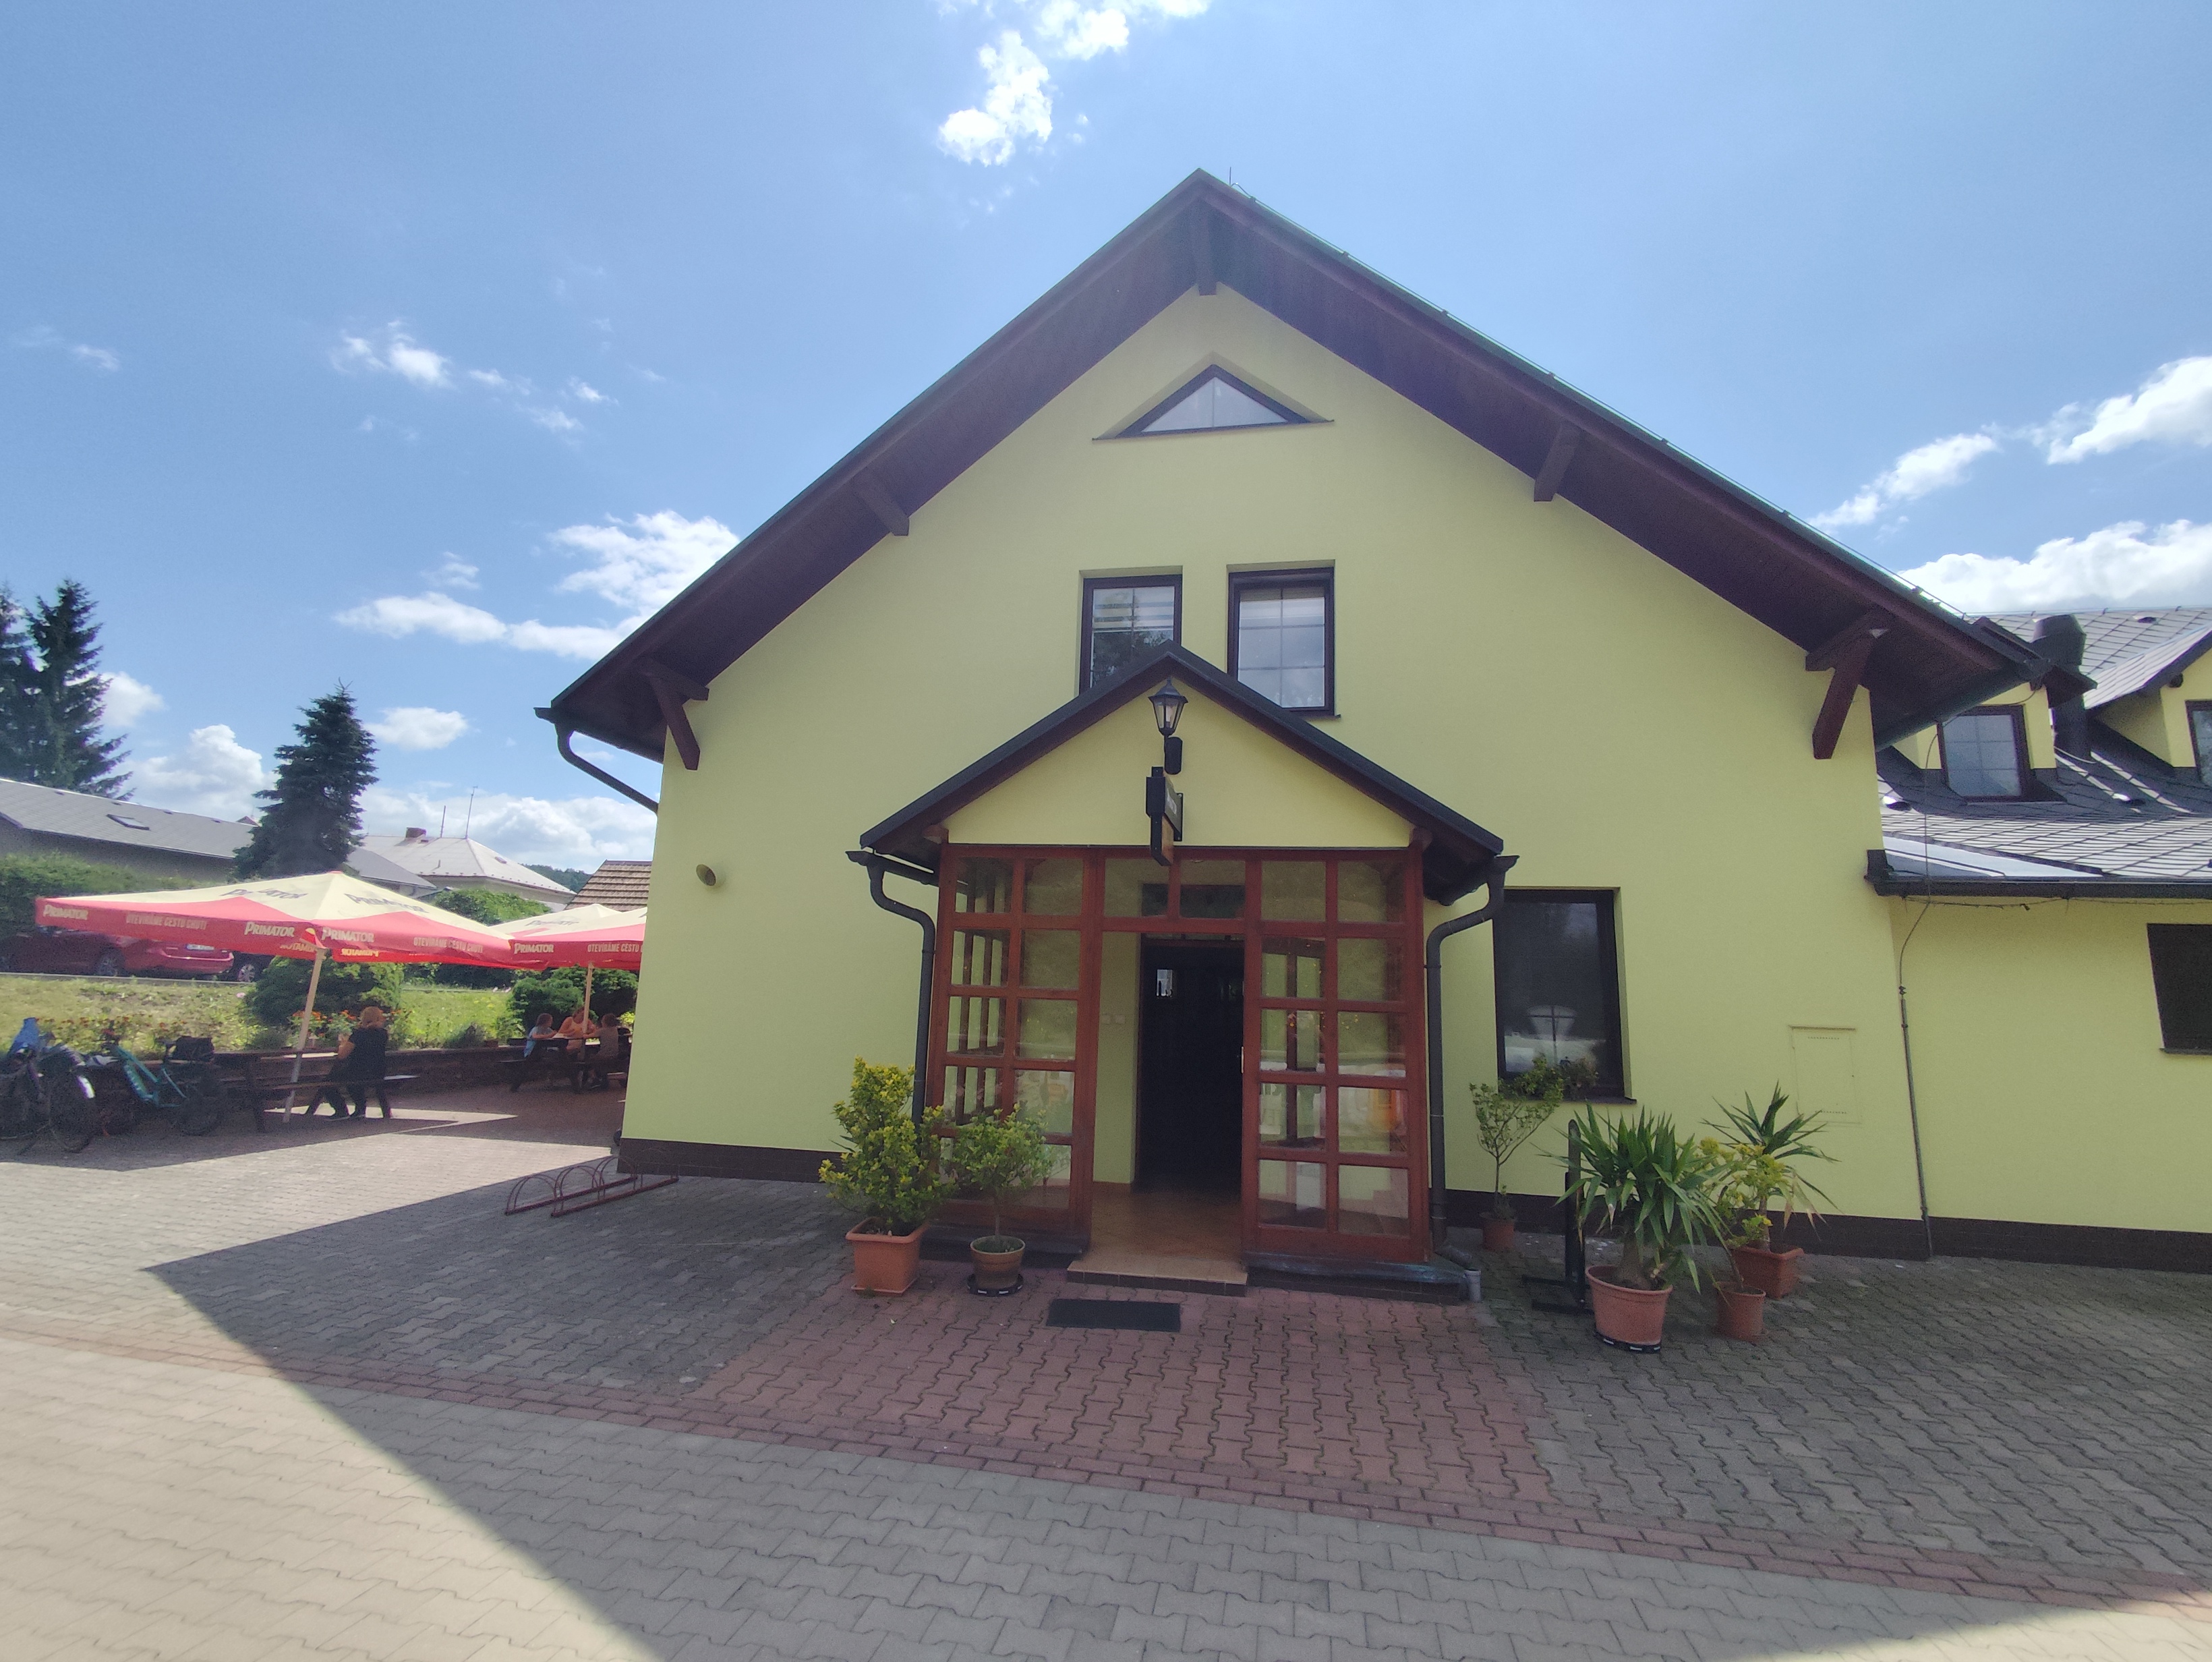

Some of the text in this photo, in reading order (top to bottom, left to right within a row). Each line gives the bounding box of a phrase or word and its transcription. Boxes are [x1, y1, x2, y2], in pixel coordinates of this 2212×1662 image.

[43, 905, 88, 921] PRIMATOR
[244, 921, 295, 938] PRIMATOR
[321, 927, 374, 943] PRIMATOR
[514, 943, 554, 954] PRIMATOR
